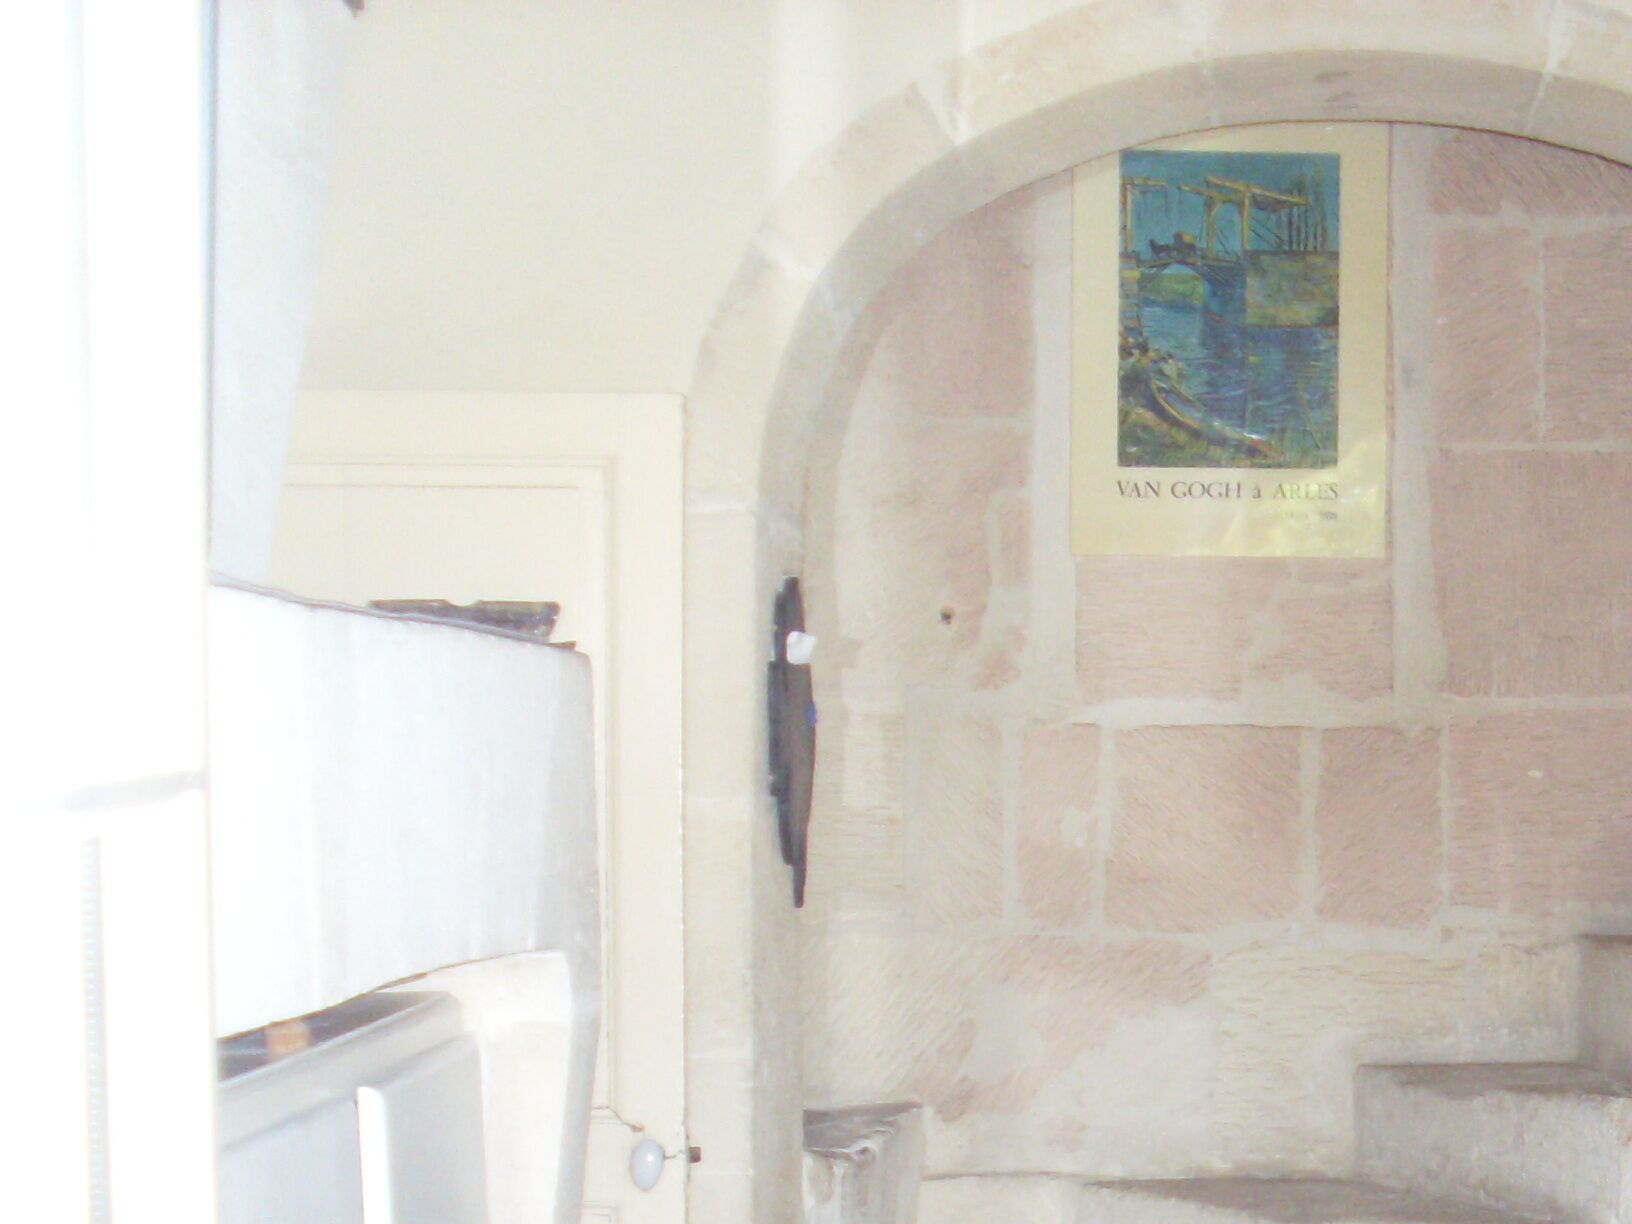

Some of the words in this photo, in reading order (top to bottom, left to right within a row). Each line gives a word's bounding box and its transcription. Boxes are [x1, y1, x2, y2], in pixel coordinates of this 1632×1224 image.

[1116, 480, 1161, 499] VAN
[1170, 481, 1241, 500] GOGH
[1273, 482, 1339, 501] ARLES
